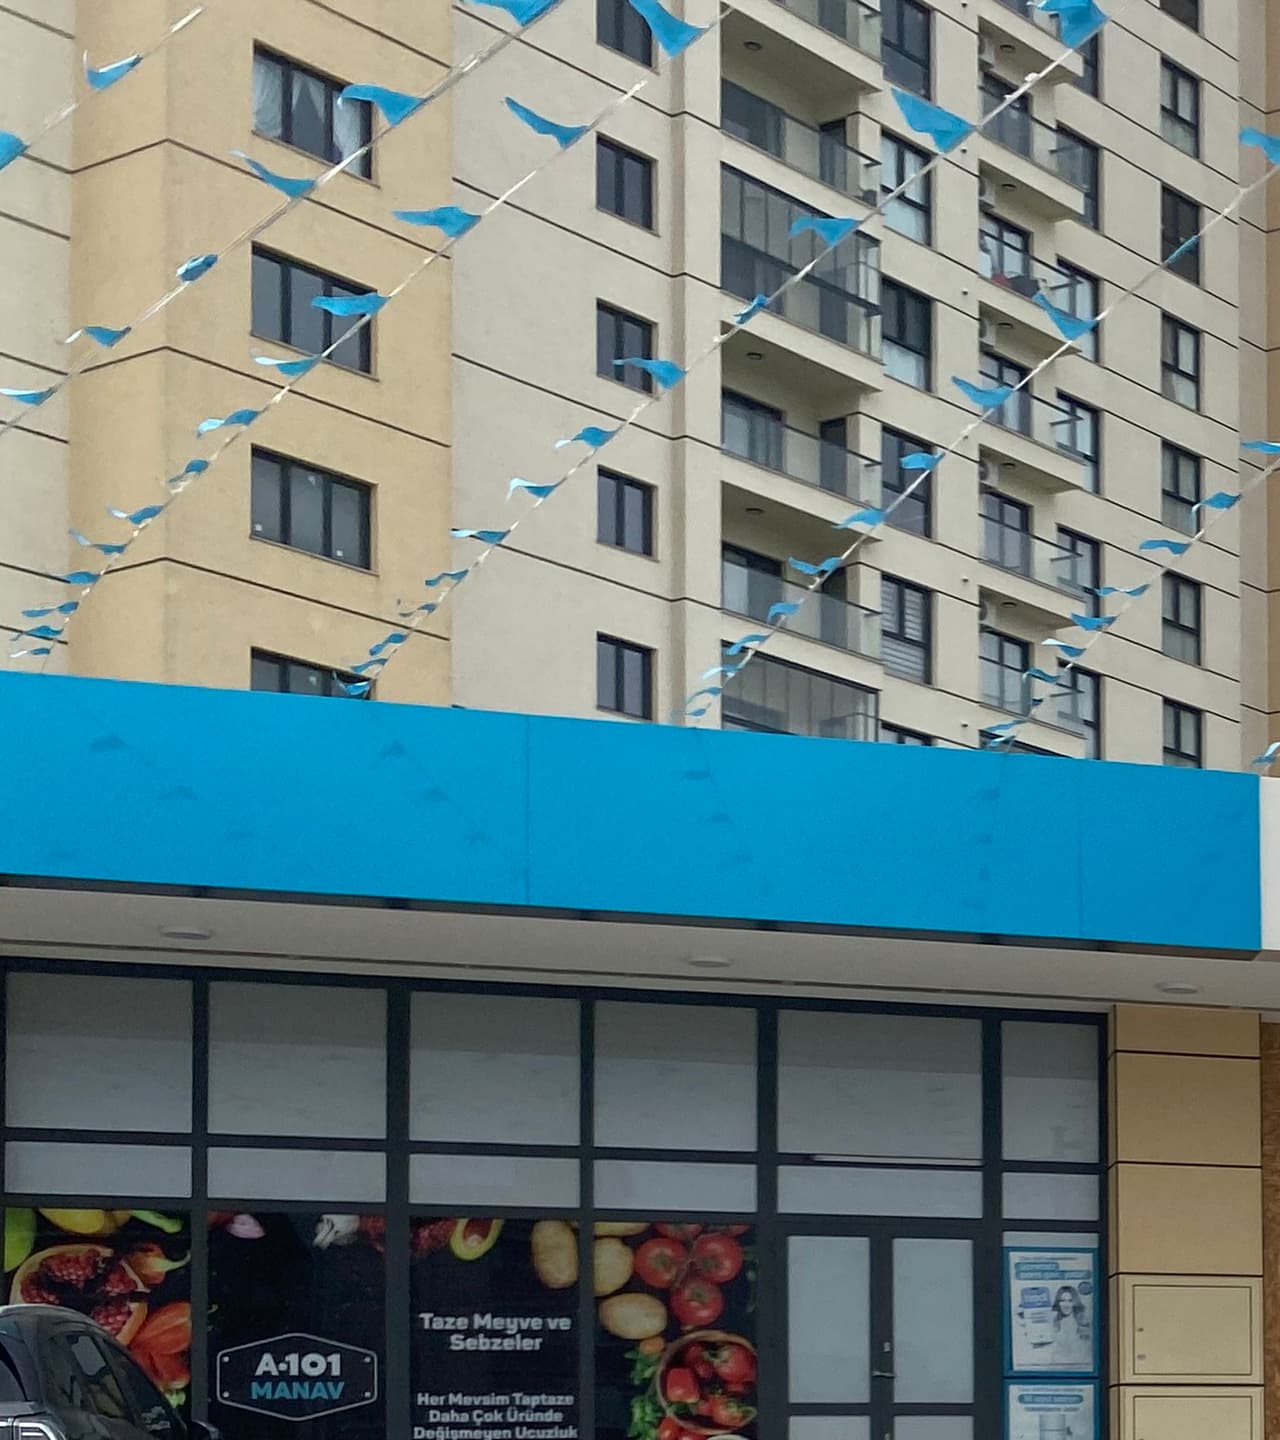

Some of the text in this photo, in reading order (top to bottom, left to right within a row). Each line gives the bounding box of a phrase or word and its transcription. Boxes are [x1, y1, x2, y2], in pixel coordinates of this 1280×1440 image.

[418, 1312, 572, 1334] Taze Meyve ve
[449, 1333, 543, 1351] Sebzeler
[251, 1381, 345, 1400] MANAV
[417, 1392, 445, 1406] Her
[448, 1392, 510, 1406] Mevsim
[429, 1406, 564, 1426] Daha Çok Üründe
[515, 1425, 578, 1440] Ucuzluk
